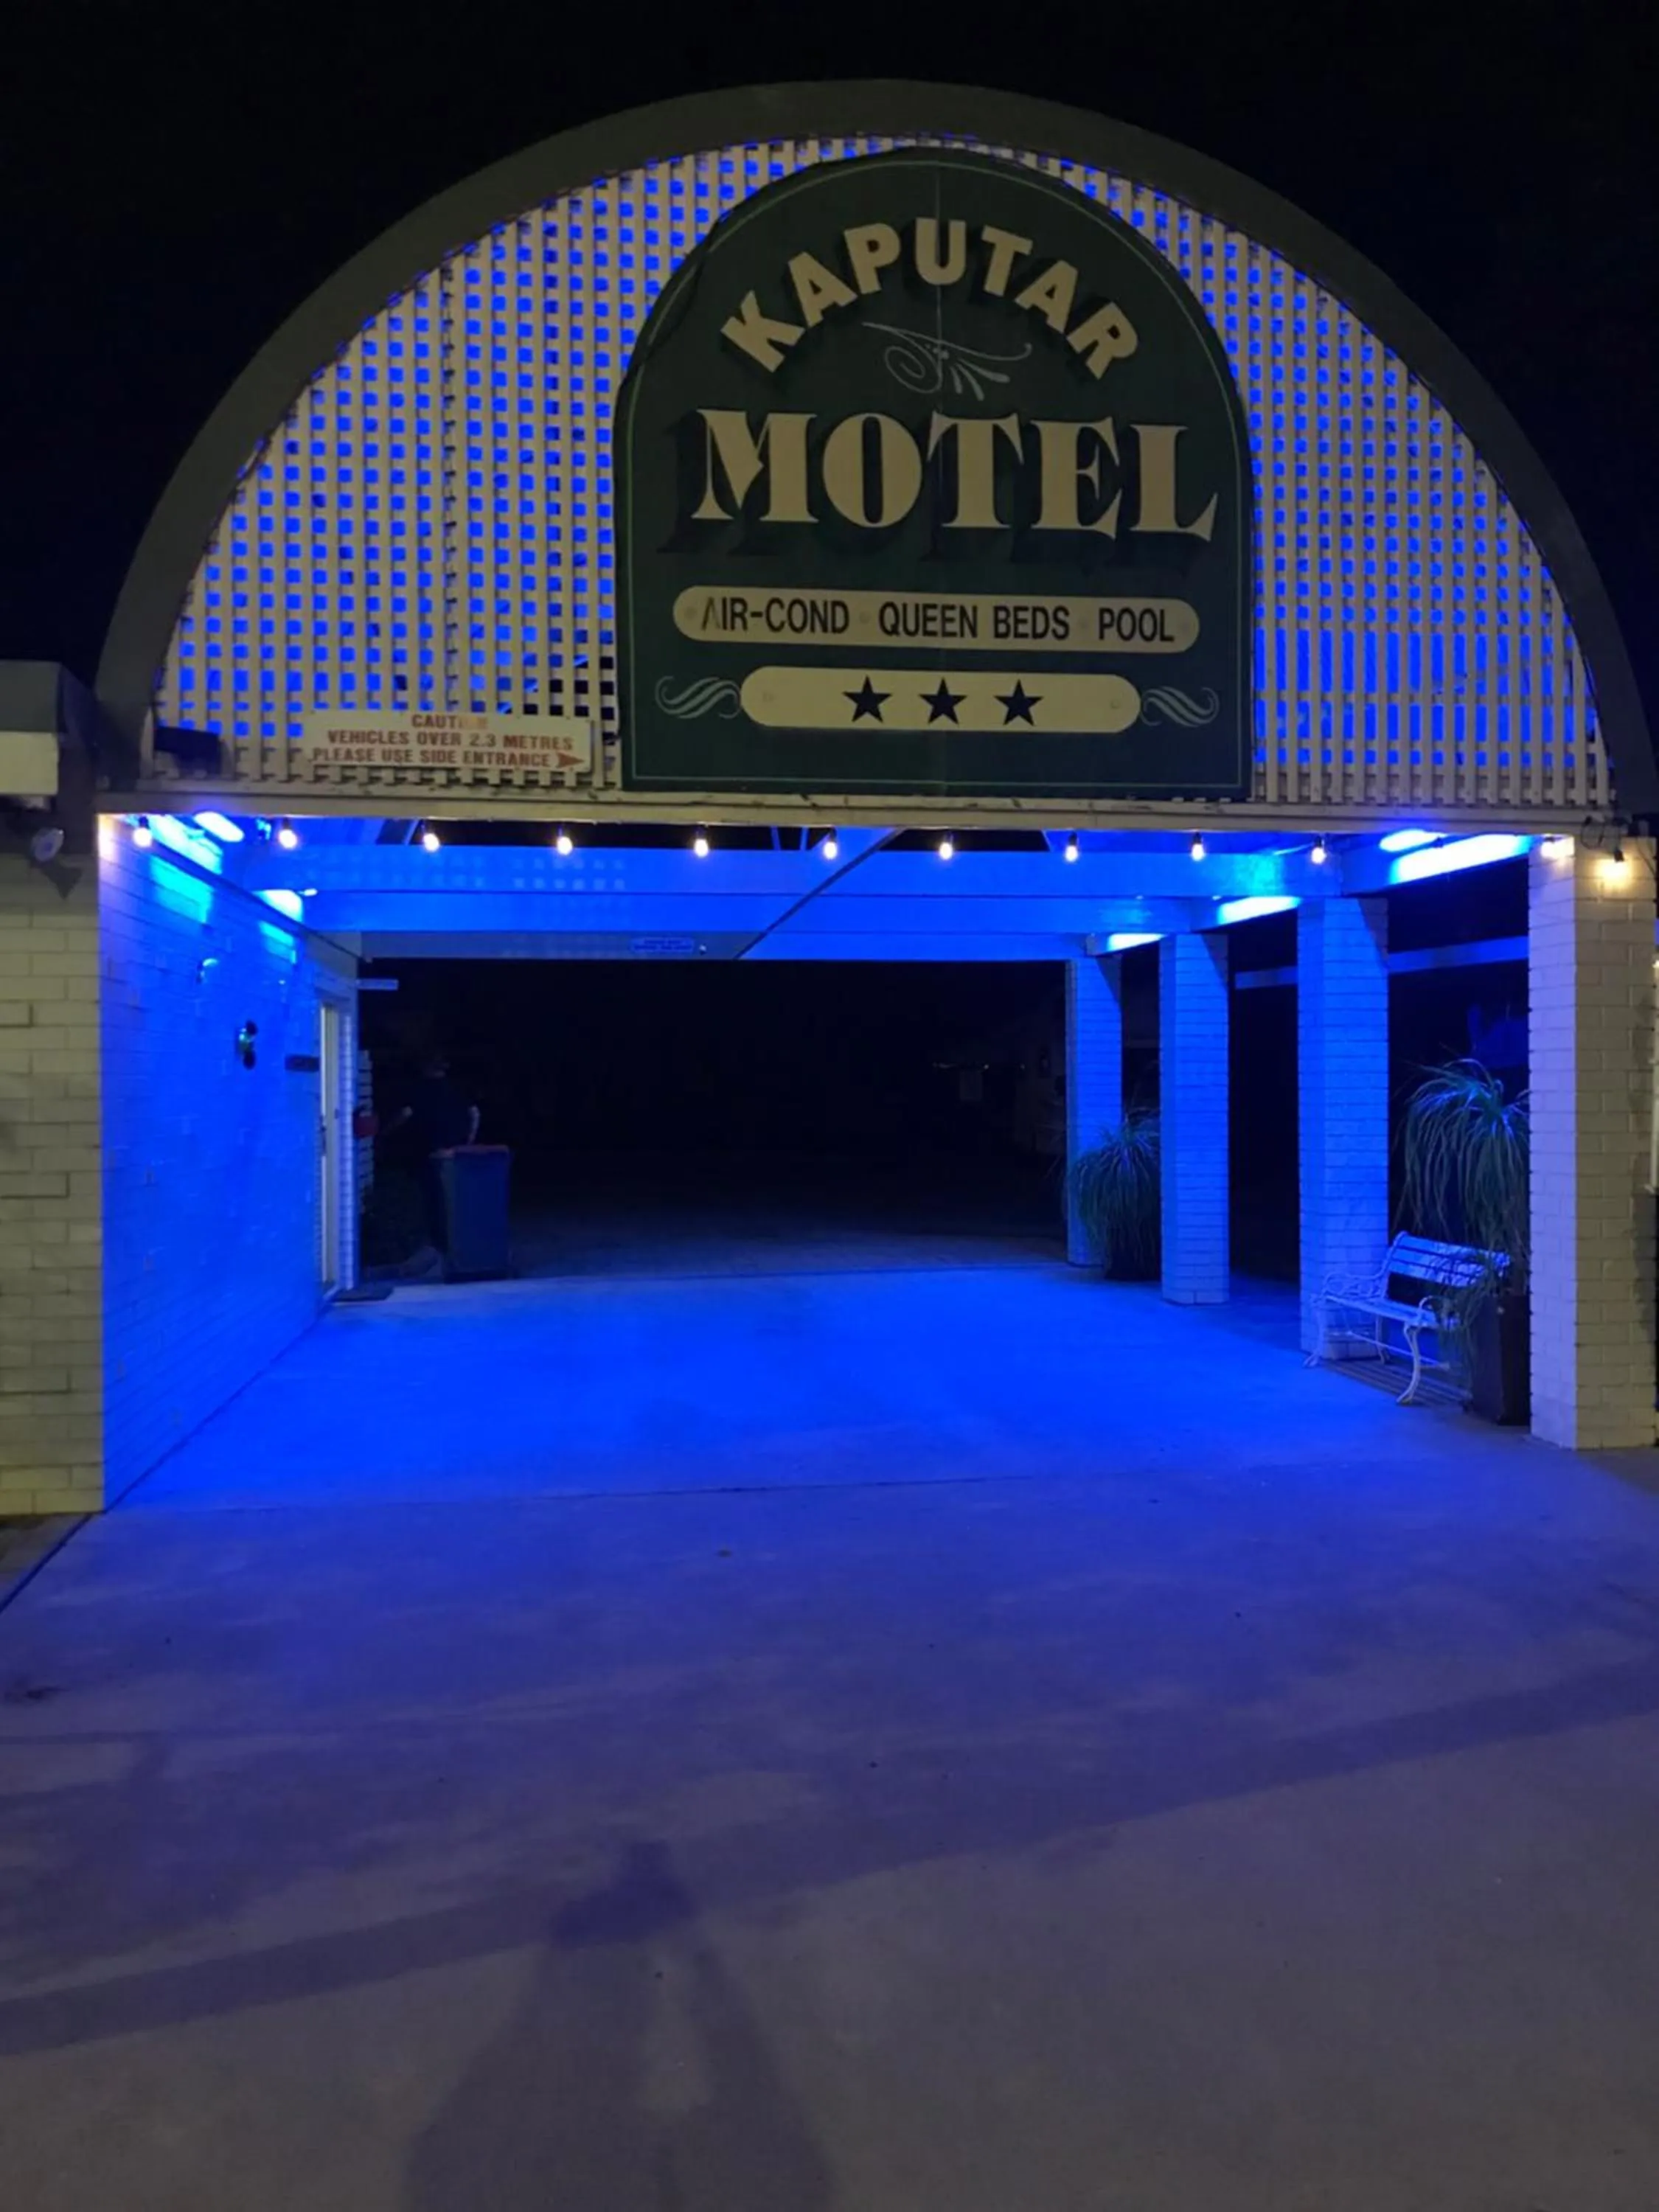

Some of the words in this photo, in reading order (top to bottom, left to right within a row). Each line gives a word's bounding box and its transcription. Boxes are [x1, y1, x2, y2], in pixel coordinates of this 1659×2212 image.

[720, 217, 1138, 379] KAPUTAR
[691, 408, 1218, 542] MOTEL
[700, 597, 850, 635] AIR-COND
[878, 602, 978, 639] QUEEN
[993, 606, 1071, 641] BEDS
[1097, 607, 1175, 642] POOL
[411, 714, 488, 729] CAUT
[327, 730, 410, 745] VEHICLES
[417, 733, 462, 746] OVER
[469, 733, 496, 747] 2.3
[503, 734, 574, 750] METRES
[313, 747, 376, 762] PLEASE
[381, 748, 413, 764] USE
[420, 749, 456, 764] SIDE
[462, 751, 550, 767] ENTRANCE
